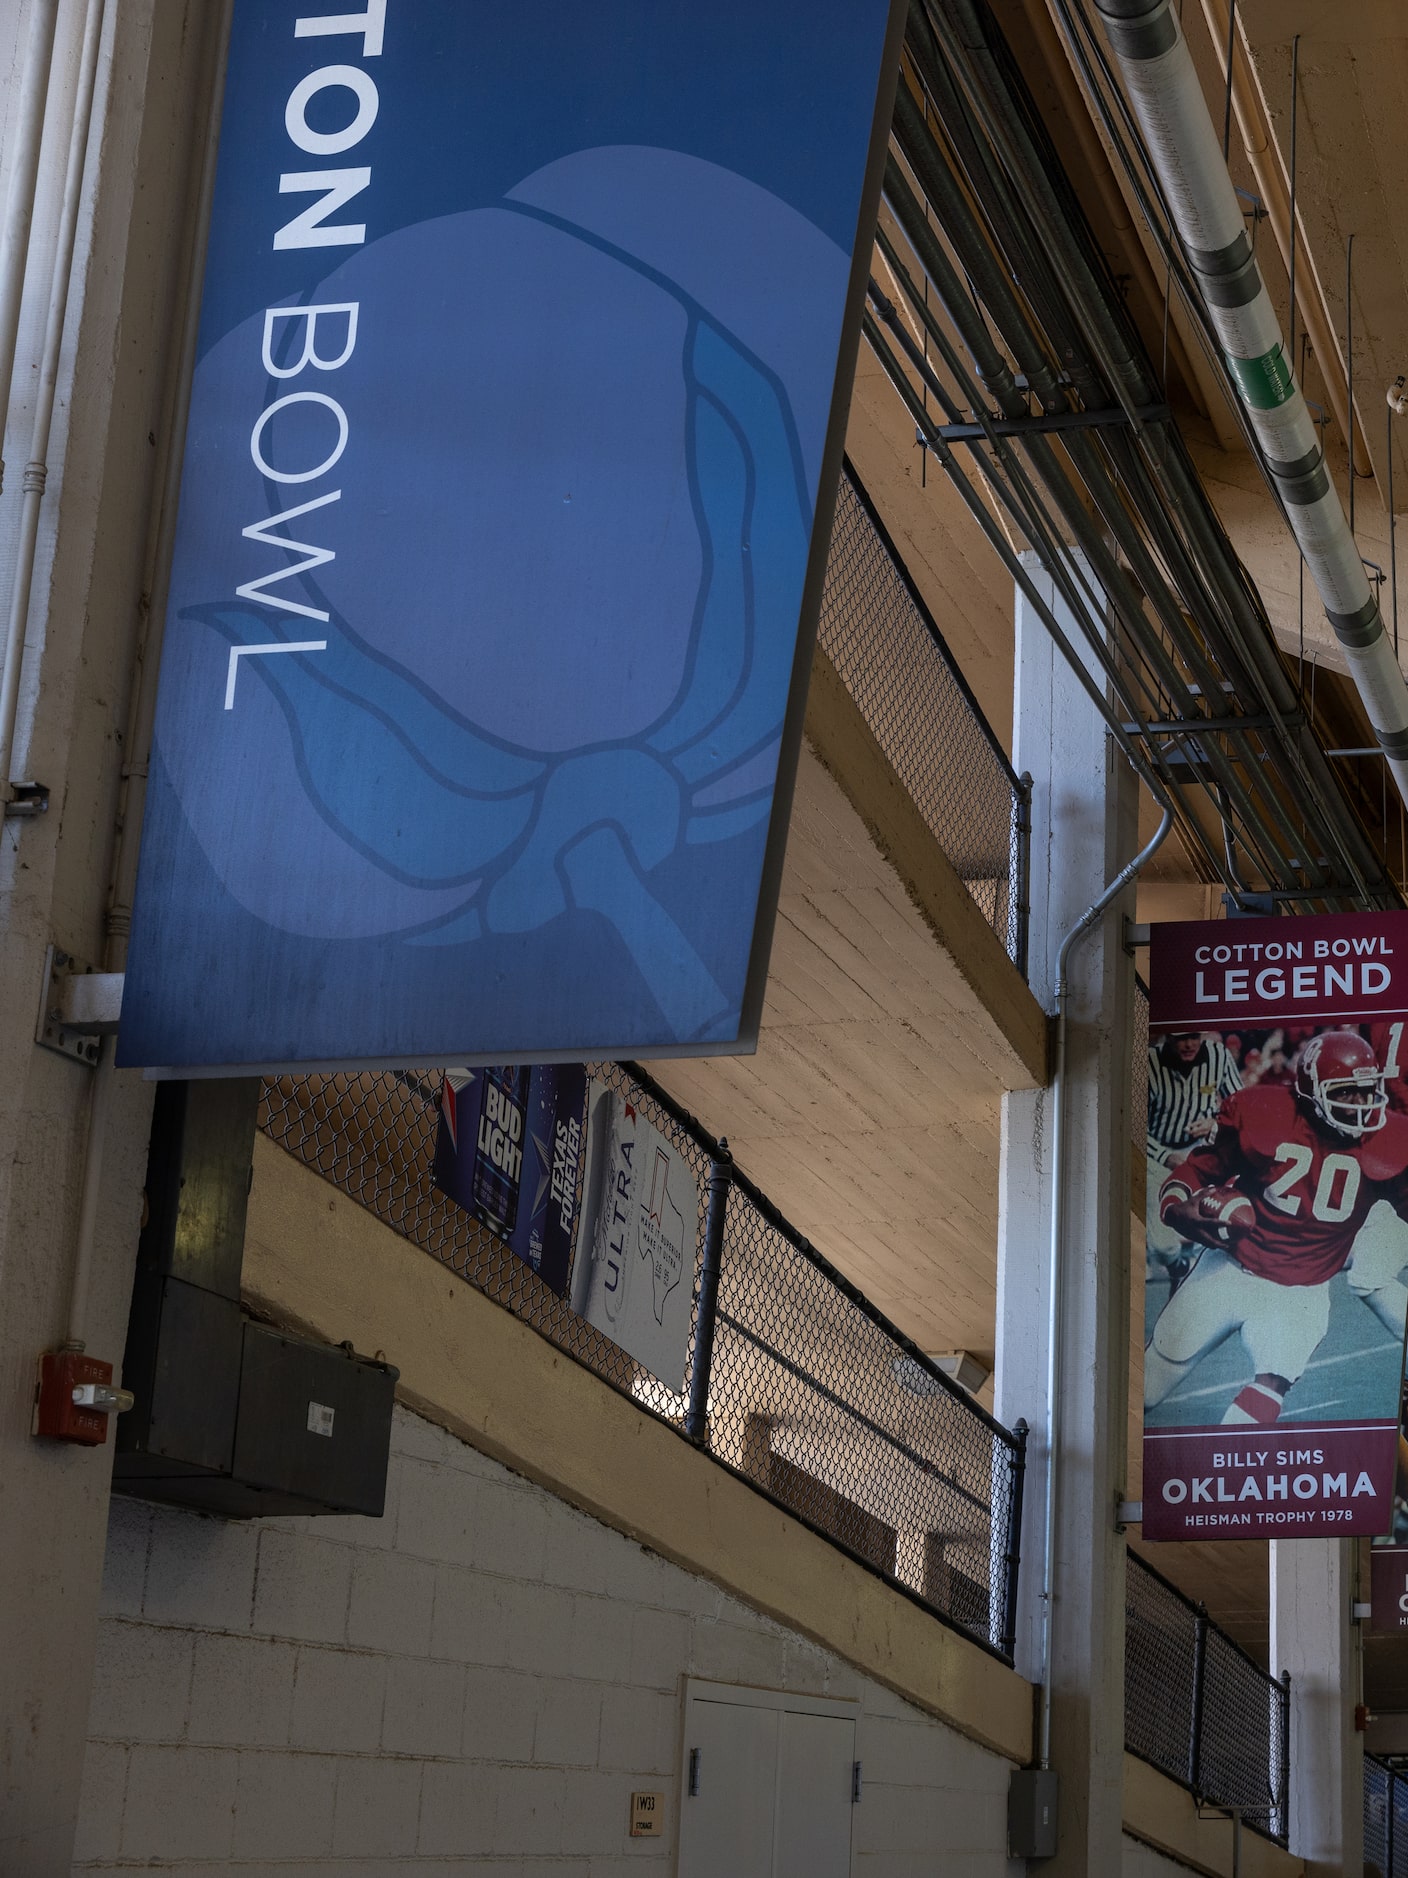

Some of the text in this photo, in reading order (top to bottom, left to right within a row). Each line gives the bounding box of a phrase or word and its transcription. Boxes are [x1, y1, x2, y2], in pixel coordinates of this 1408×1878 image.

[225, 0, 387, 711] TON BOWL
[1195, 936, 1394, 964] COTTON BOWL
[1195, 962, 1392, 1004] LEGEND
[486, 1082, 523, 1143] BUD
[477, 1115, 523, 1184] LIGHT
[549, 1119, 569, 1206] TEXAS
[559, 1116, 582, 1235] FOREVER
[1263, 1142, 1361, 1223] 20
[604, 1142, 635, 1292] ULTRA
[640, 1214, 654, 1230] MAKE
[654, 1227, 661, 1239] IT
[642, 1230, 656, 1250] MAKE
[83, 1365, 104, 1379] FIRE
[78, 1416, 99, 1430] FIRE
[1213, 1449, 1325, 1468] BILLY SIMS
[1161, 1471, 1378, 1504] OKLAHOMA
[1185, 1509, 1353, 1526] HEISMAN TROPHY 1978
